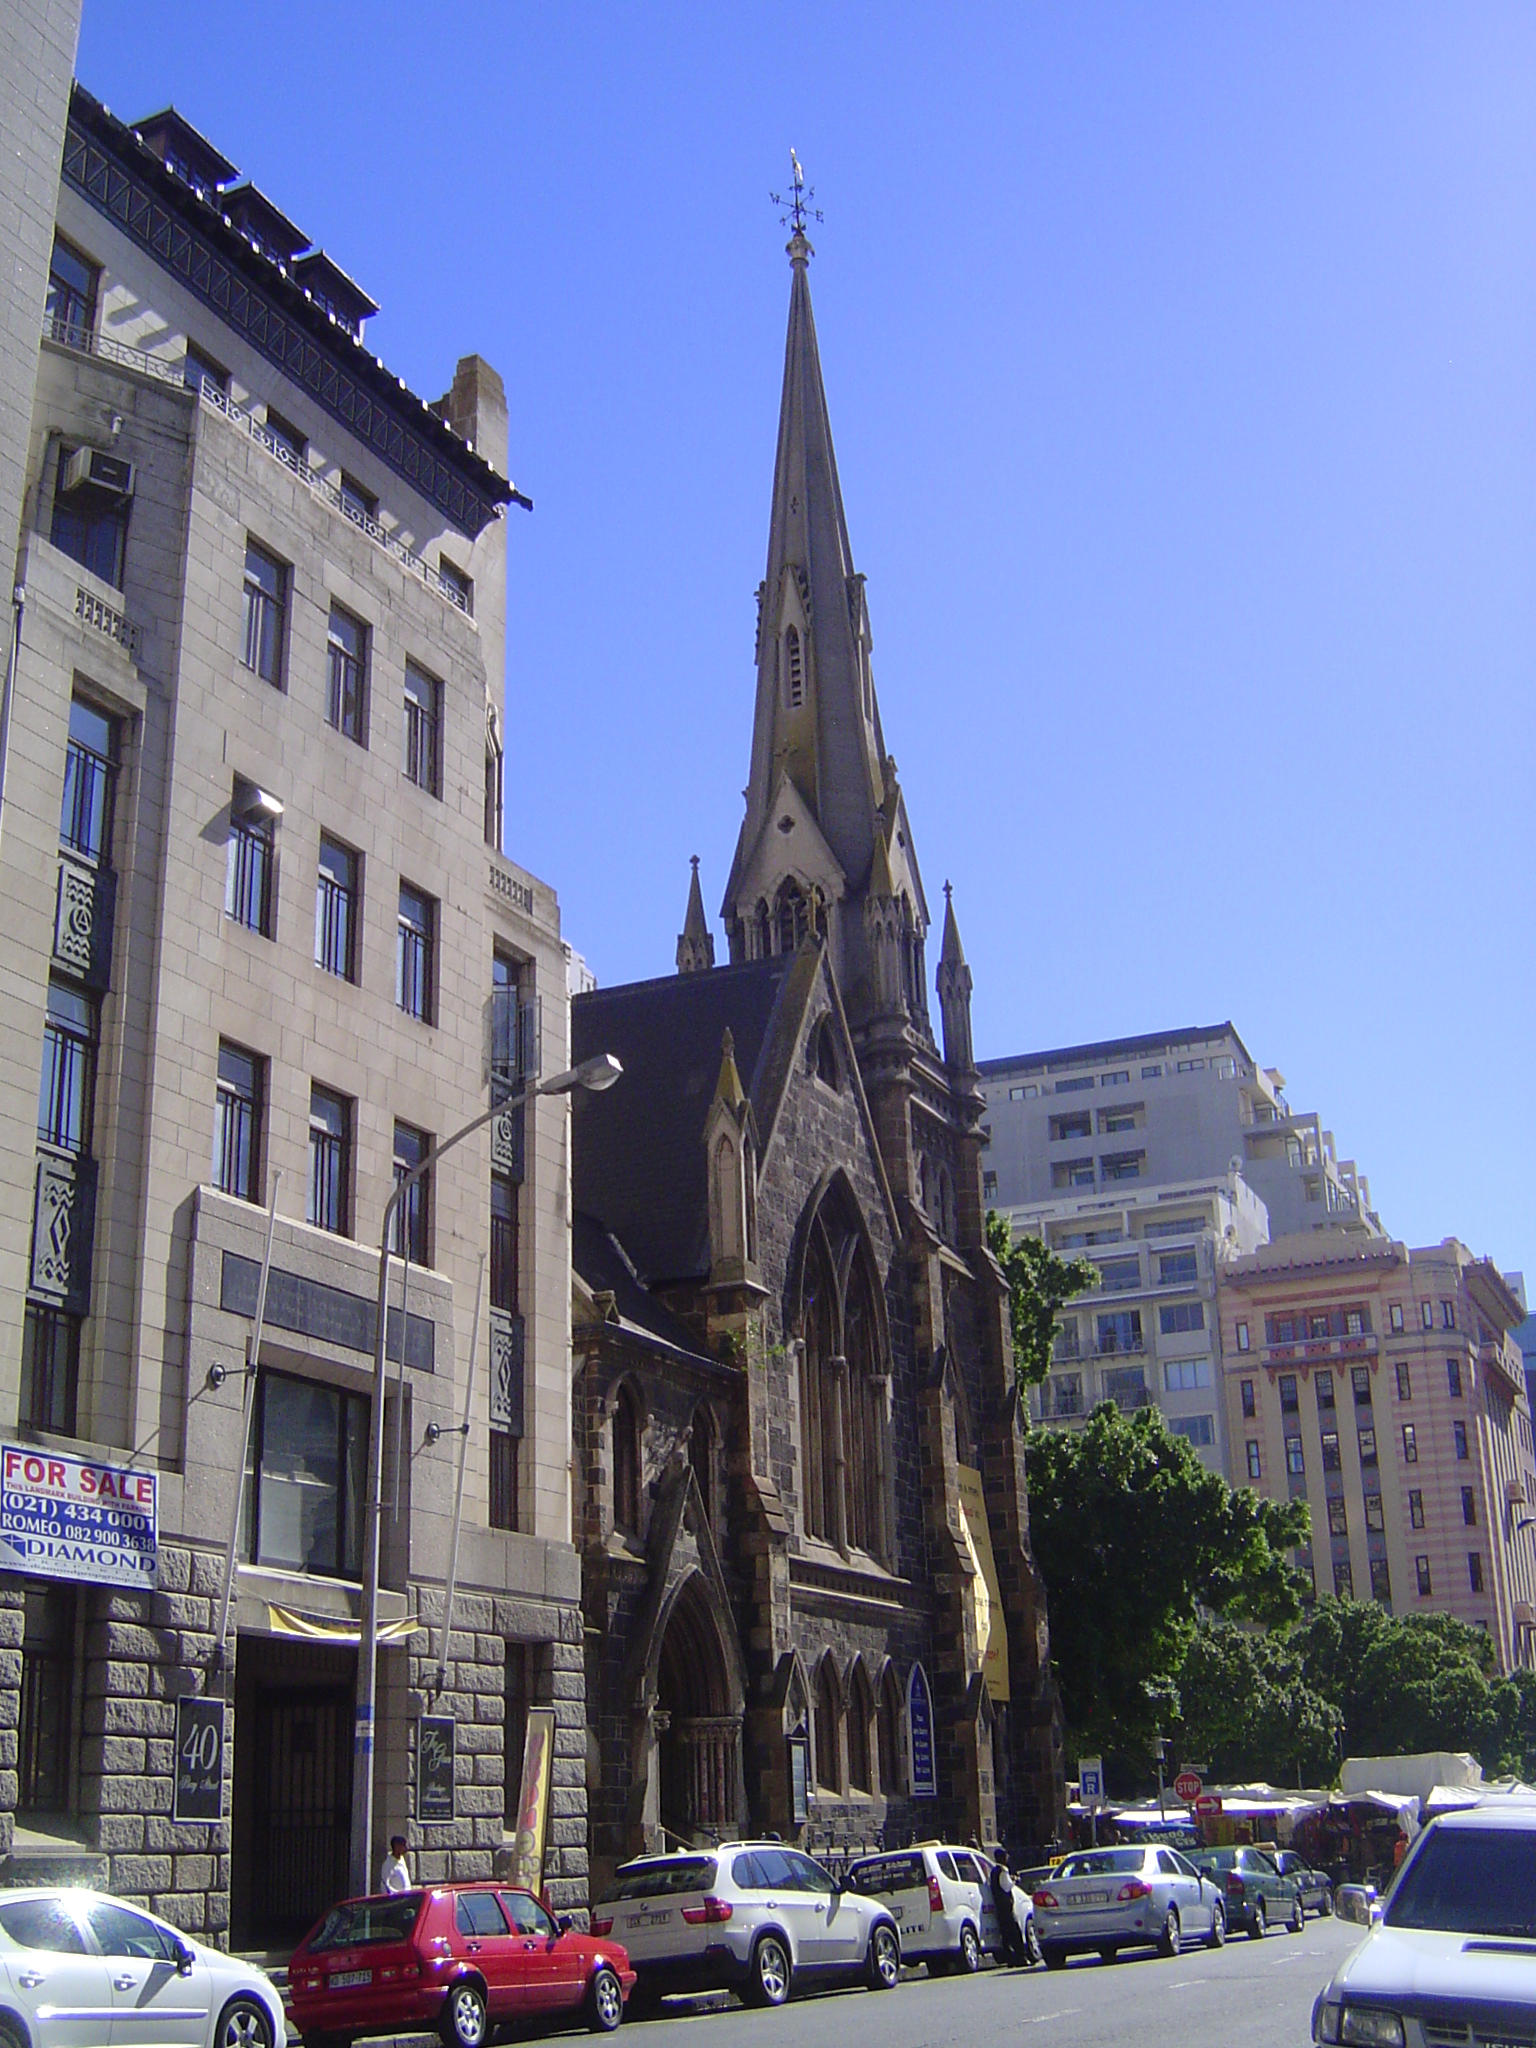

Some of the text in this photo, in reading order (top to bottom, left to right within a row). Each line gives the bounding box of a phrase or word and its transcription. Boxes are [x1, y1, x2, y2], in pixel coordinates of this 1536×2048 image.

[6, 1453, 153, 1504] FOR SALE
[6, 1481, 152, 1514] THIS LANDMARK BUILDING WITH PARKING
[2, 1512, 155, 1552] ROMEO 082 900 3638
[3, 1491, 154, 1533] (021) 434 0001
[27, 1539, 156, 1573] DIAMOND
[182, 1723, 218, 1770] 40
[1177, 1781, 1200, 1794] STOP
